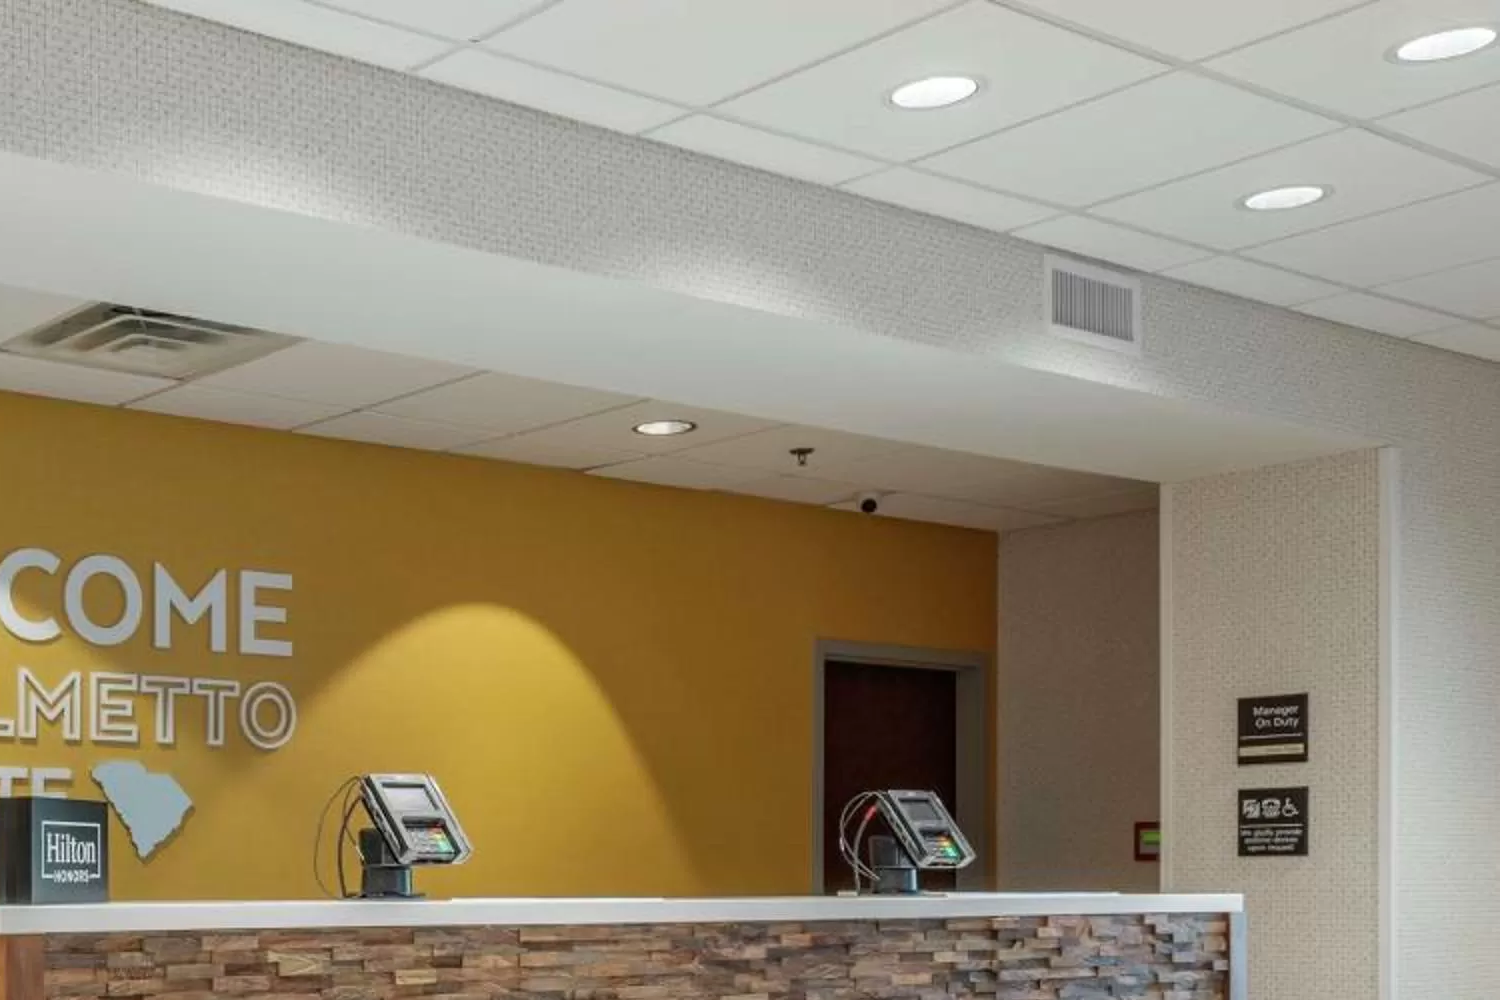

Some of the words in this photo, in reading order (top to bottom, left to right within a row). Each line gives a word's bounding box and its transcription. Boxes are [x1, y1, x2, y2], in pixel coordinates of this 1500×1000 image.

[1253, 705, 1299, 717] Manager
[1255, 718, 1272, 729] On
[46, 832, 97, 864] Hilton
